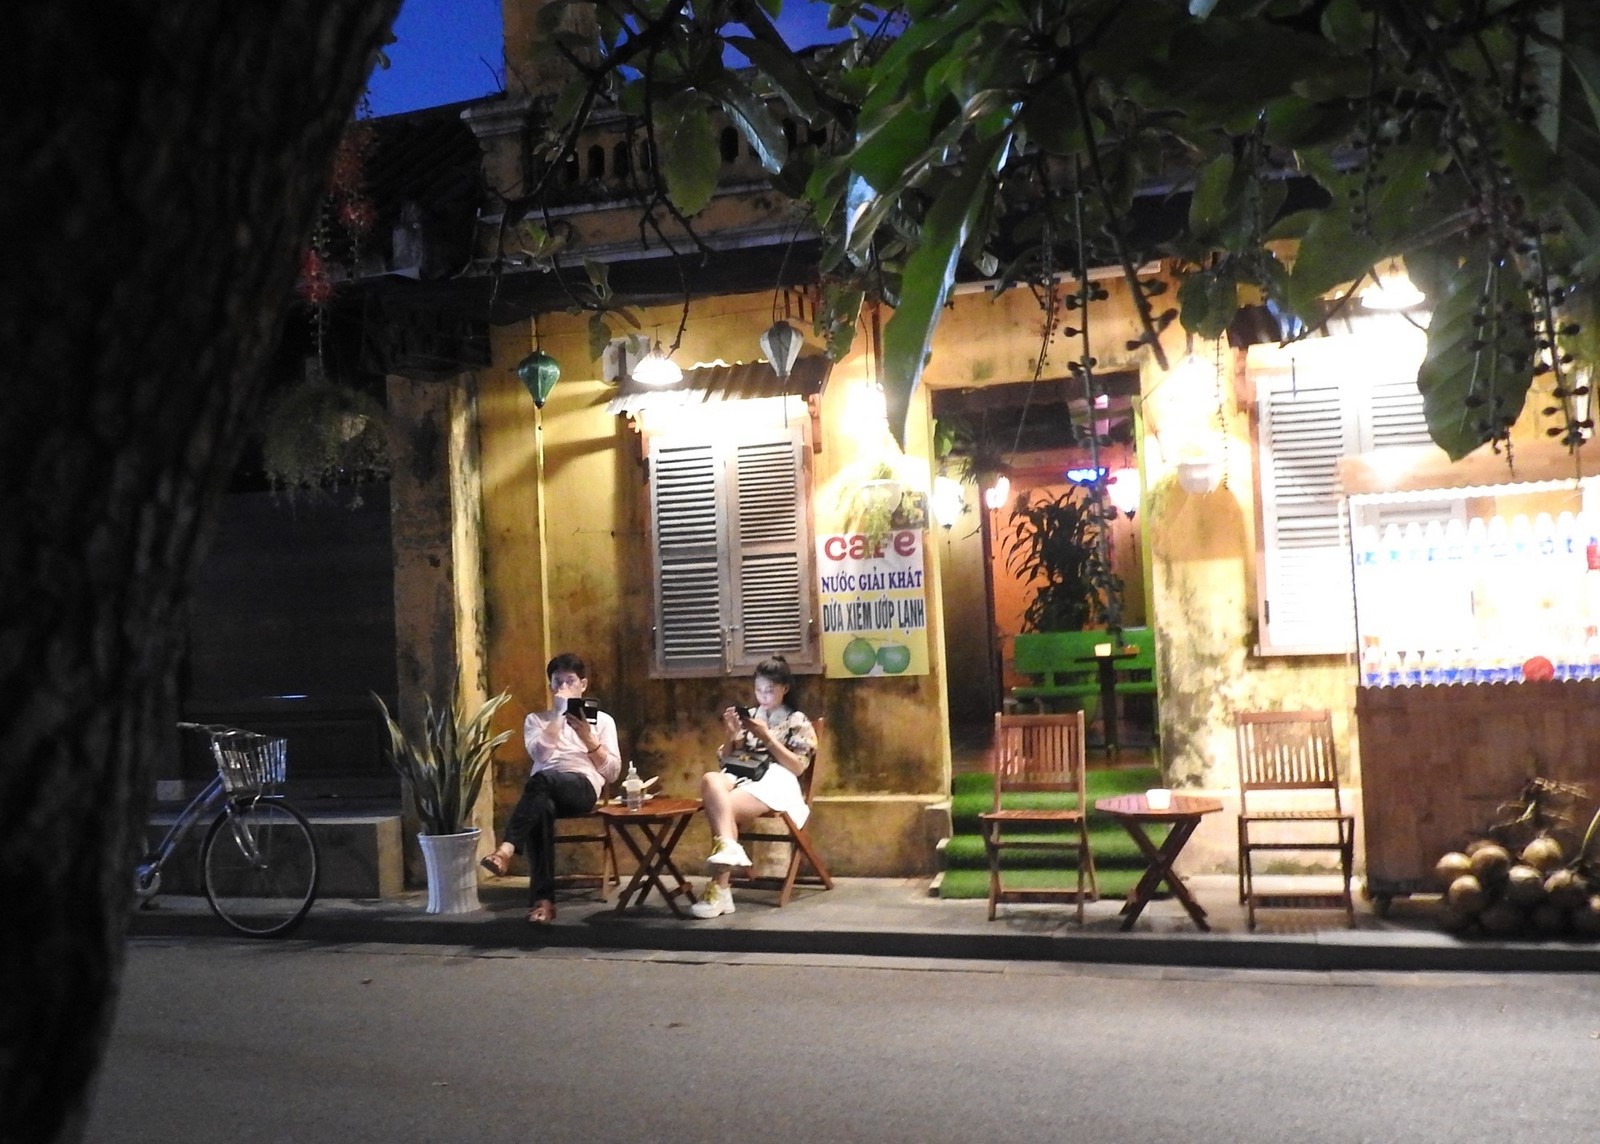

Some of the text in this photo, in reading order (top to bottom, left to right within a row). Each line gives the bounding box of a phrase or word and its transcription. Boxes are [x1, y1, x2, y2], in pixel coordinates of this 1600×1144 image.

[821, 566, 922, 593] NƯỚC GIẢI KHÁT
[822, 595, 925, 634] DỪA XIÊM ƯỚP LẠNH
